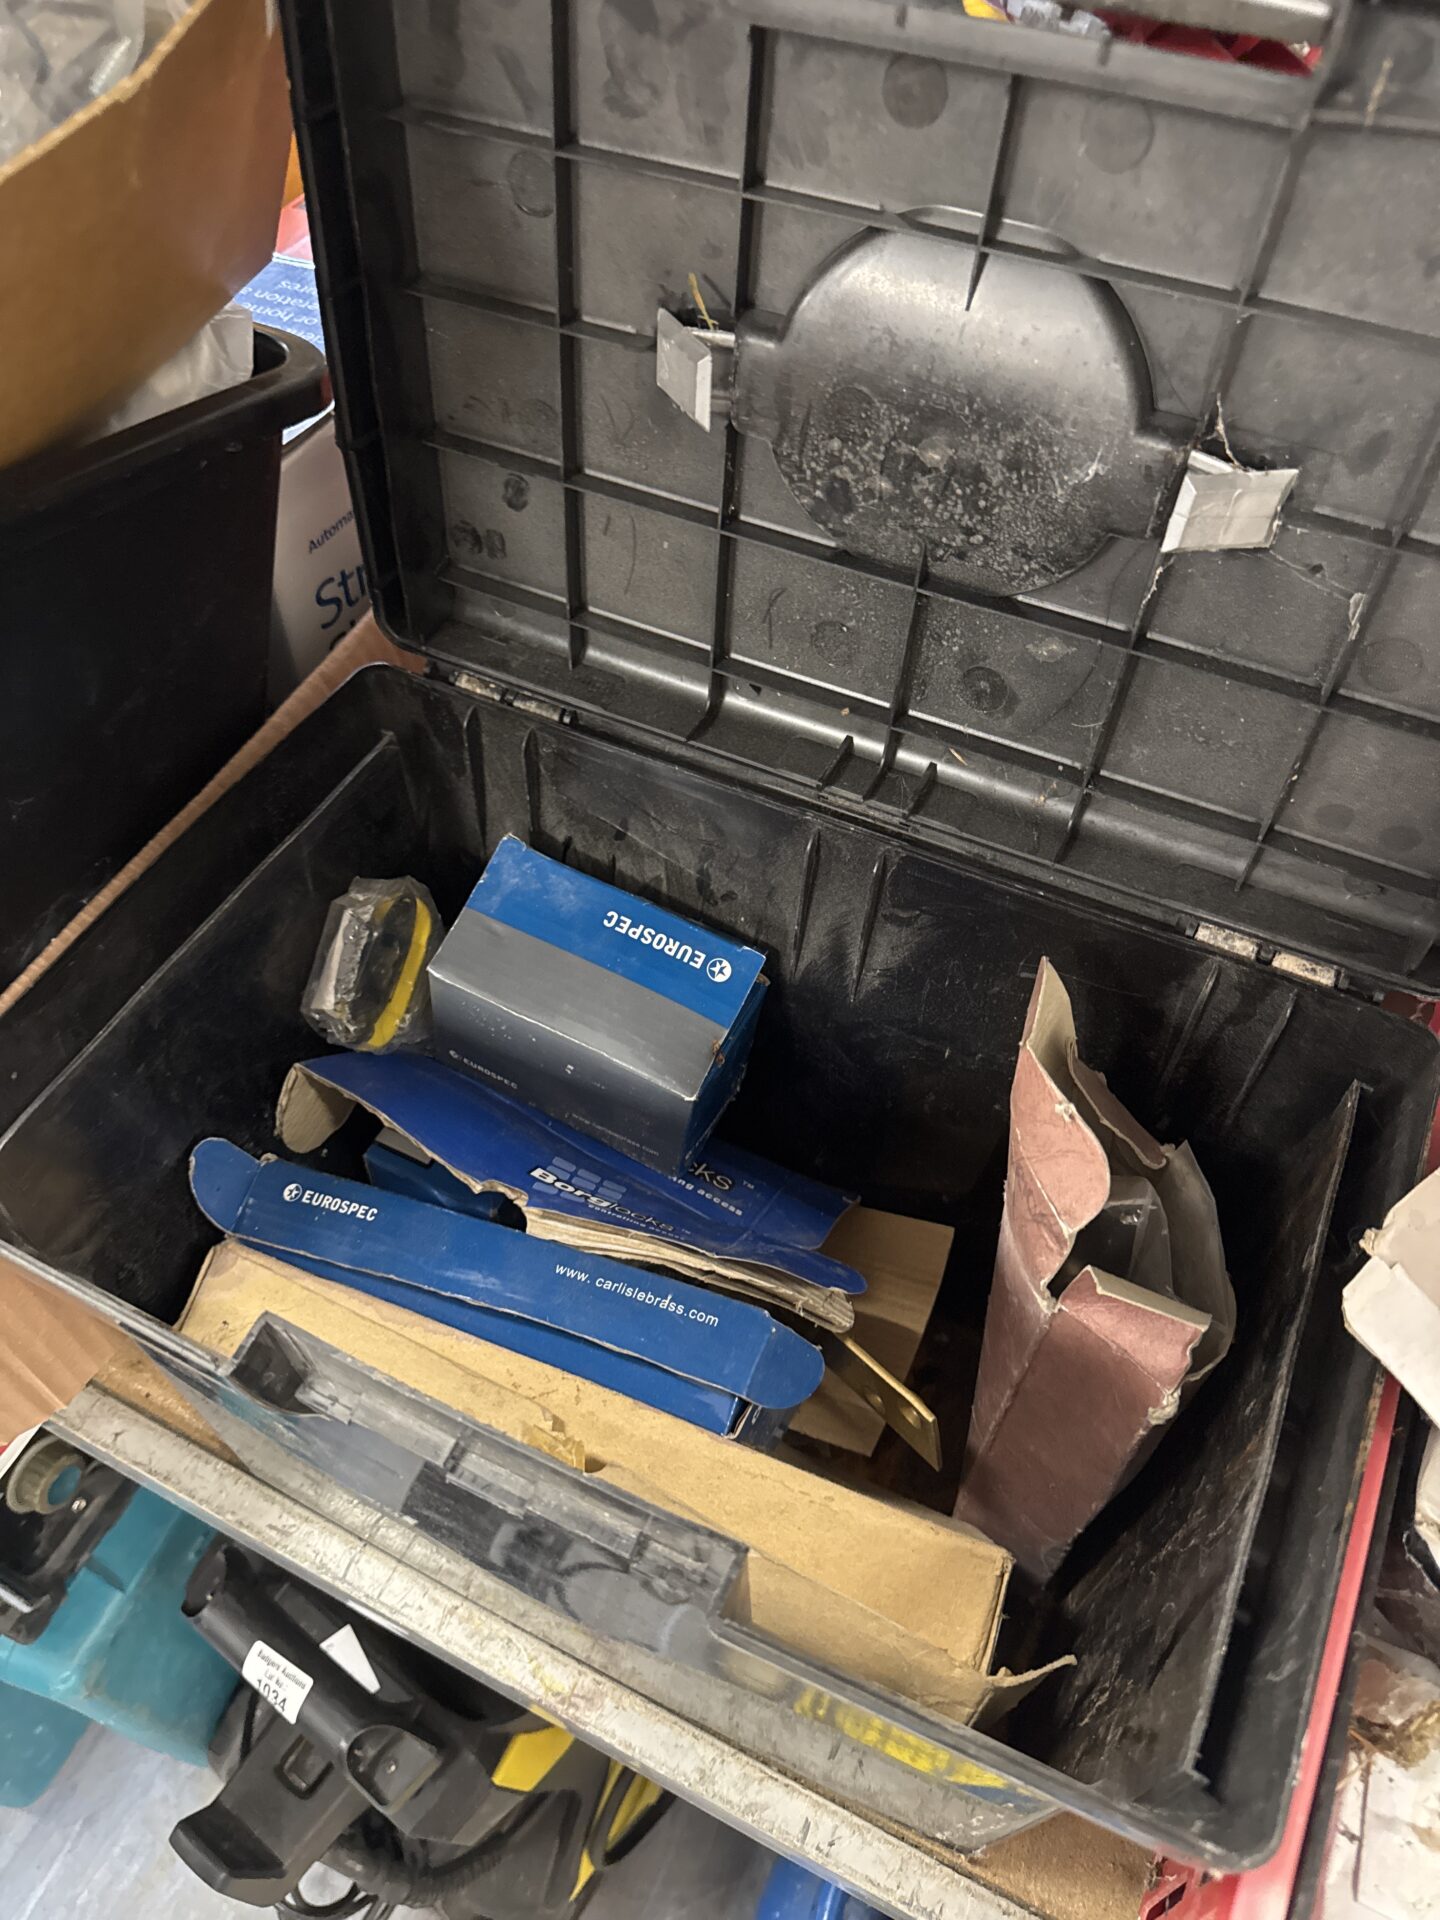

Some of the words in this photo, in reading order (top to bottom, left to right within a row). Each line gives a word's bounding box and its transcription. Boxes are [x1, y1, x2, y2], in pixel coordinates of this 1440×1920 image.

[603, 911, 706, 969] EUROSPEC
[463, 1058, 518, 1090] EUROSPEC
[301, 1189, 378, 1222] EUROSPEC
[530, 1167, 674, 1232] Borglocks
[696, 1189, 743, 1217] access
